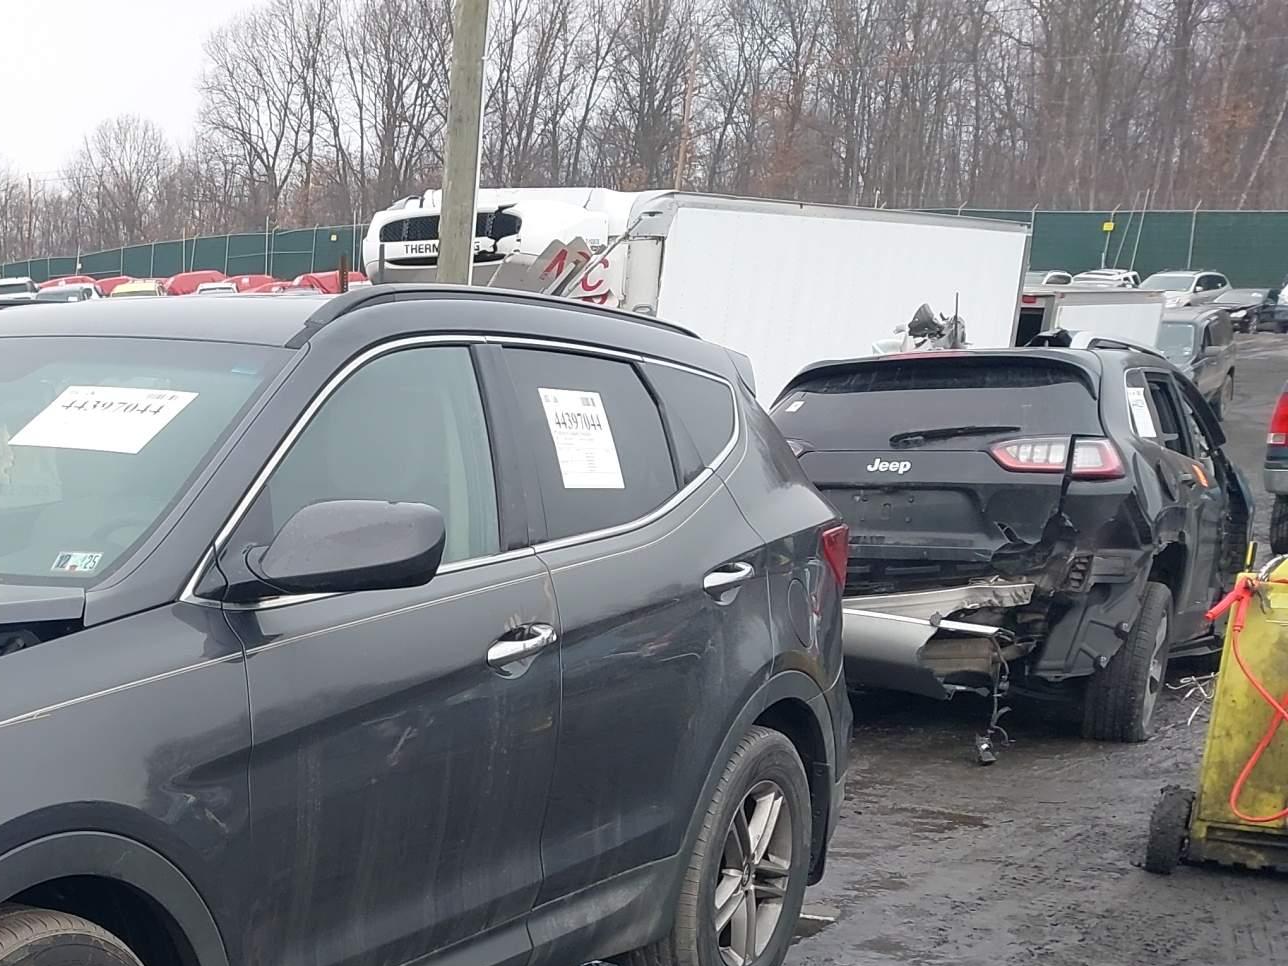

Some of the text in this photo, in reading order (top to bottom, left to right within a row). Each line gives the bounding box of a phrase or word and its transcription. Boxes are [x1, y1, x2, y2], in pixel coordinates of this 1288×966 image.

[404, 243, 439, 255] THERM
[61, 399, 165, 416] 44397044
[554, 410, 603, 431] 44397044
[866, 458, 912, 474] Jeep
